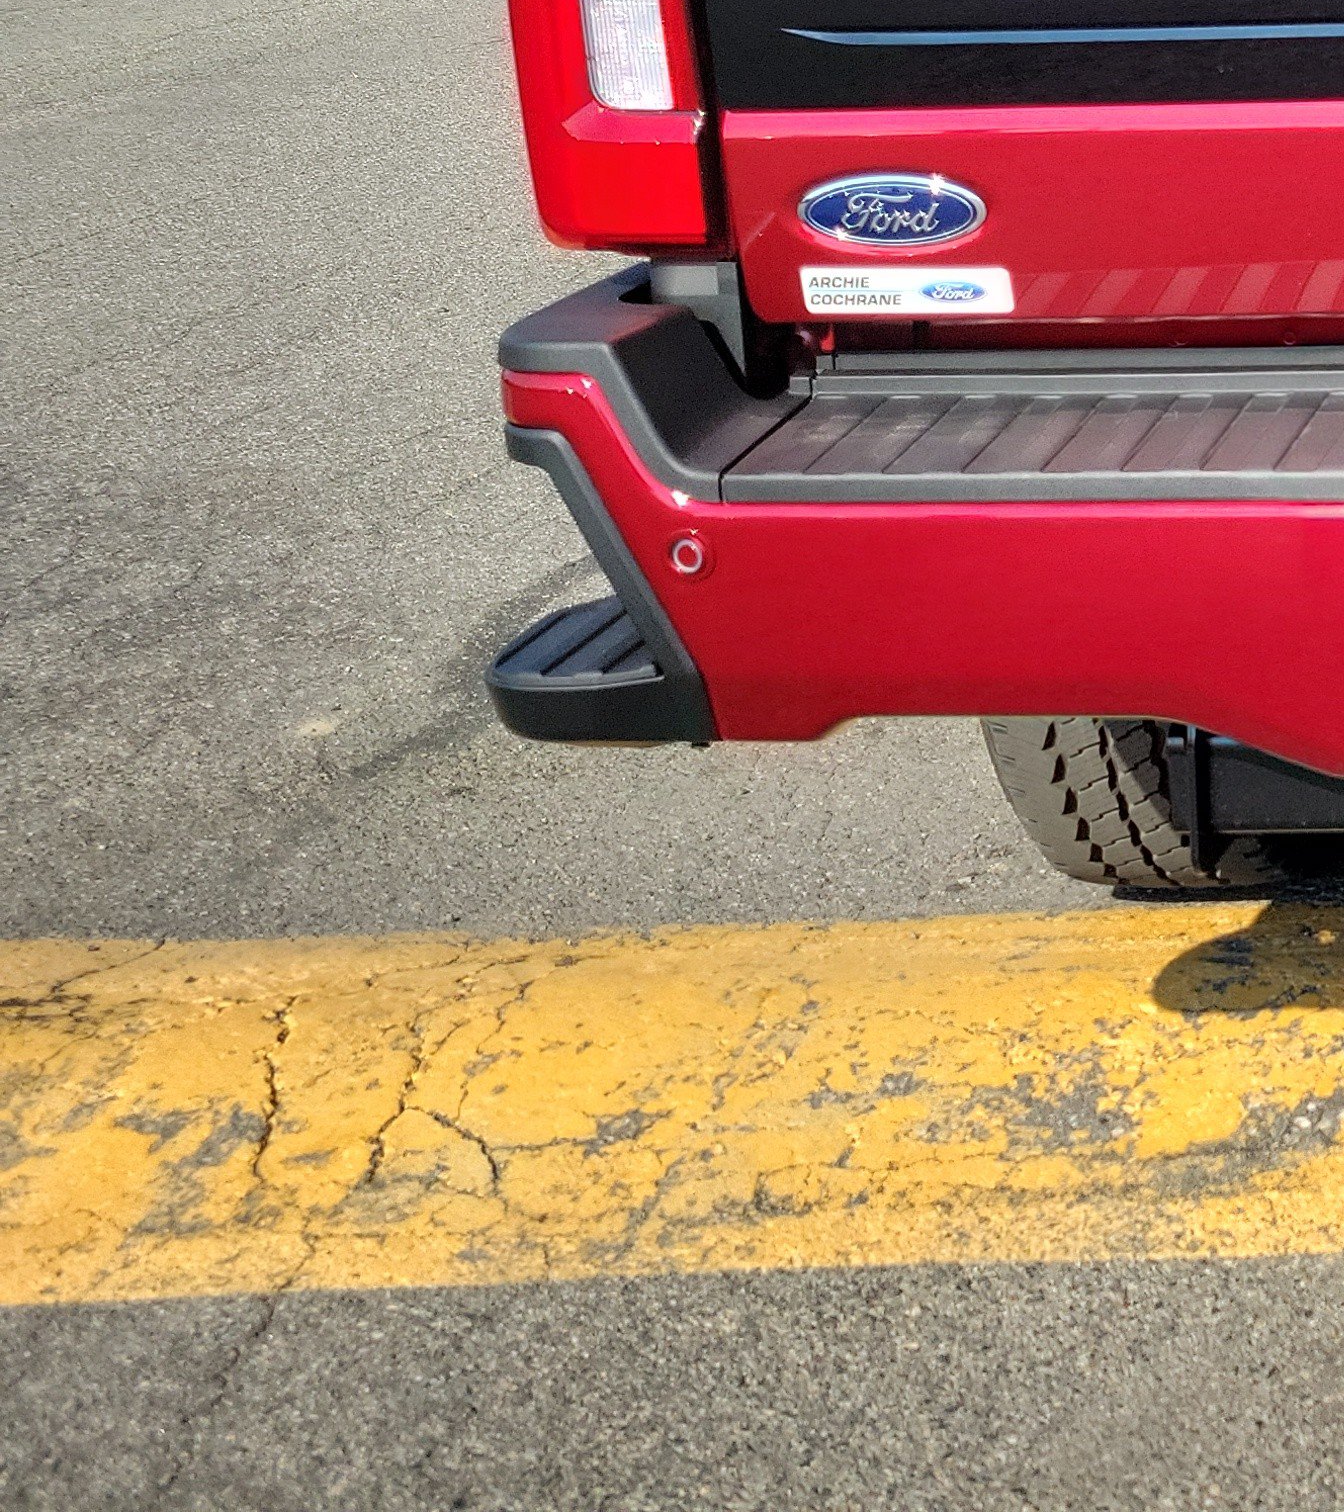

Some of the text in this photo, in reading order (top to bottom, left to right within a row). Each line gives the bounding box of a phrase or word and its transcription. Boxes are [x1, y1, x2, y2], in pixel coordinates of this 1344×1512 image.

[841, 192, 940, 234] Ford
[809, 276, 870, 289] ARCHIE
[932, 283, 975, 300] Ford
[810, 294, 902, 306] COCHRANE
